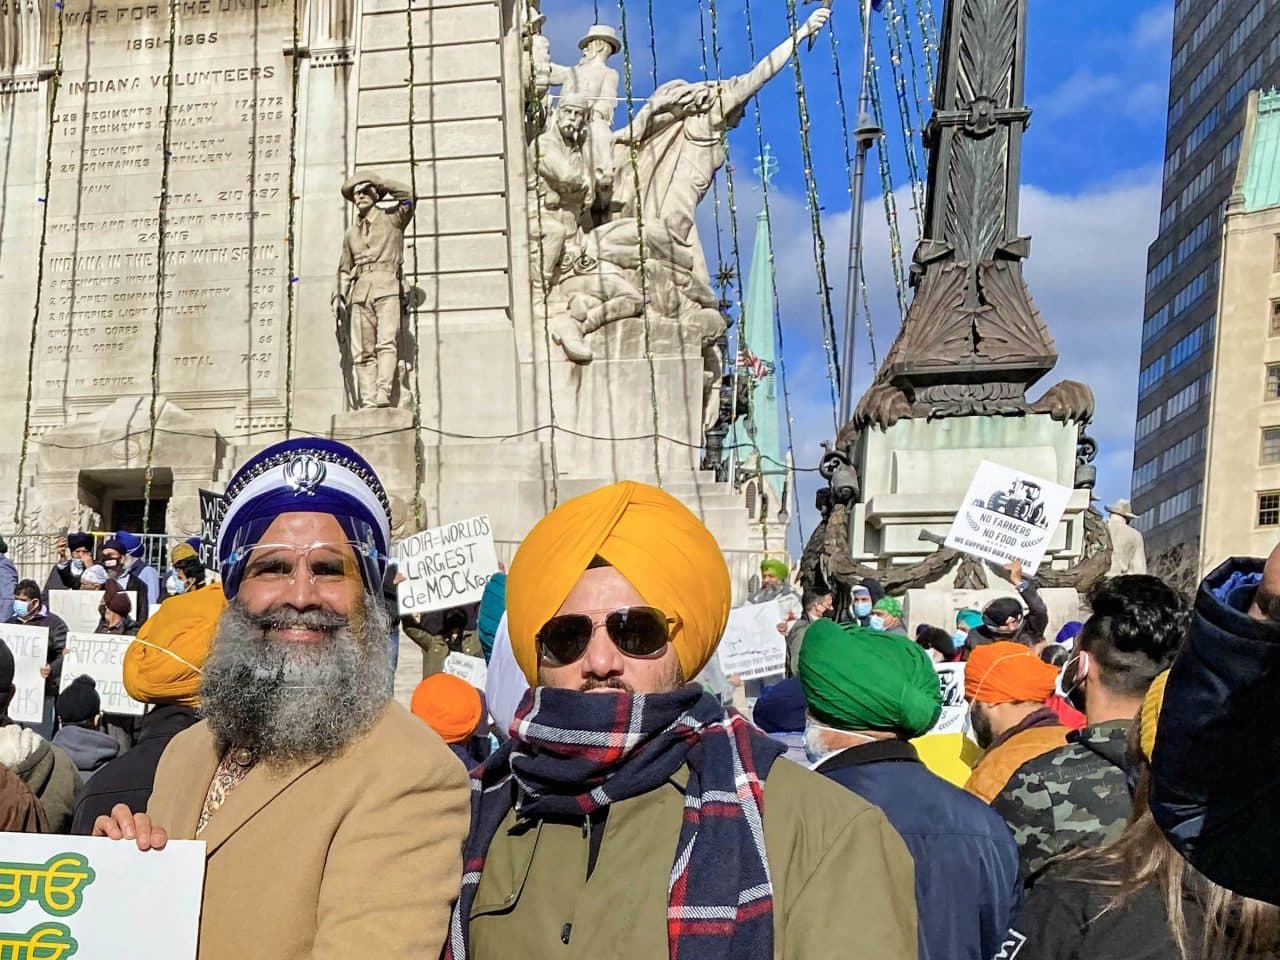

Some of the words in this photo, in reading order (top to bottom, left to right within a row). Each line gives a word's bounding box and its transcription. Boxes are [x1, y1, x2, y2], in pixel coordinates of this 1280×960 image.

[65, 10, 107, 26] WAR
[117, 5, 159, 21] FOR
[69, 77, 140, 95] INDIANA
[149, 66, 276, 89] VOLUNTEERS
[125, 251, 153, 268] THE
[191, 247, 228, 264] WITH
[980, 513, 992, 524] NO
[993, 516, 1032, 537] FARMERS
[964, 538, 992, 553] SUPPORT
[982, 527, 995, 539] NO
[996, 530, 1018, 547] FOOD
[406, 542, 478, 581] LARGEST
